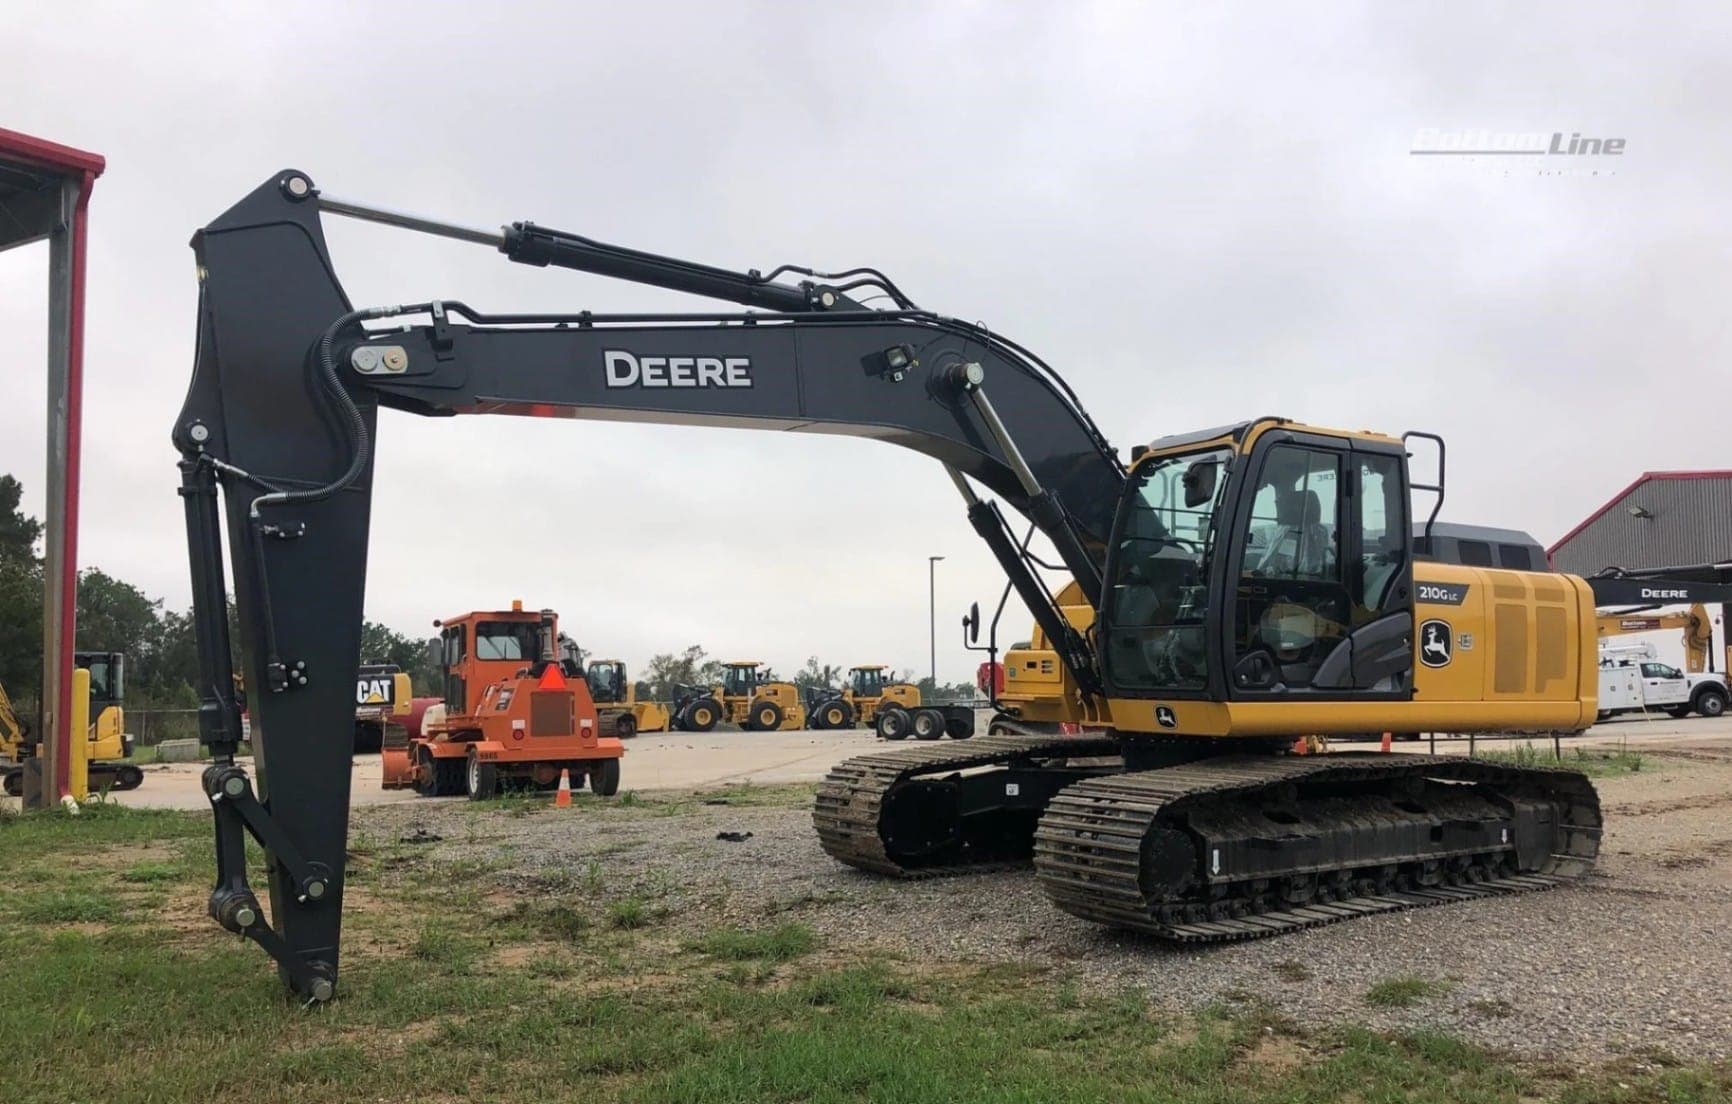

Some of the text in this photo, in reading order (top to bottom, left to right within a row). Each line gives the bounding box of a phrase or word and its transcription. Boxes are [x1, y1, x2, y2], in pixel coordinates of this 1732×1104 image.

[604, 350, 752, 387] DEERE
[1419, 586, 1448, 600] 210G
[1641, 588, 1688, 599] DEERE
[356, 680, 391, 703] CAT
